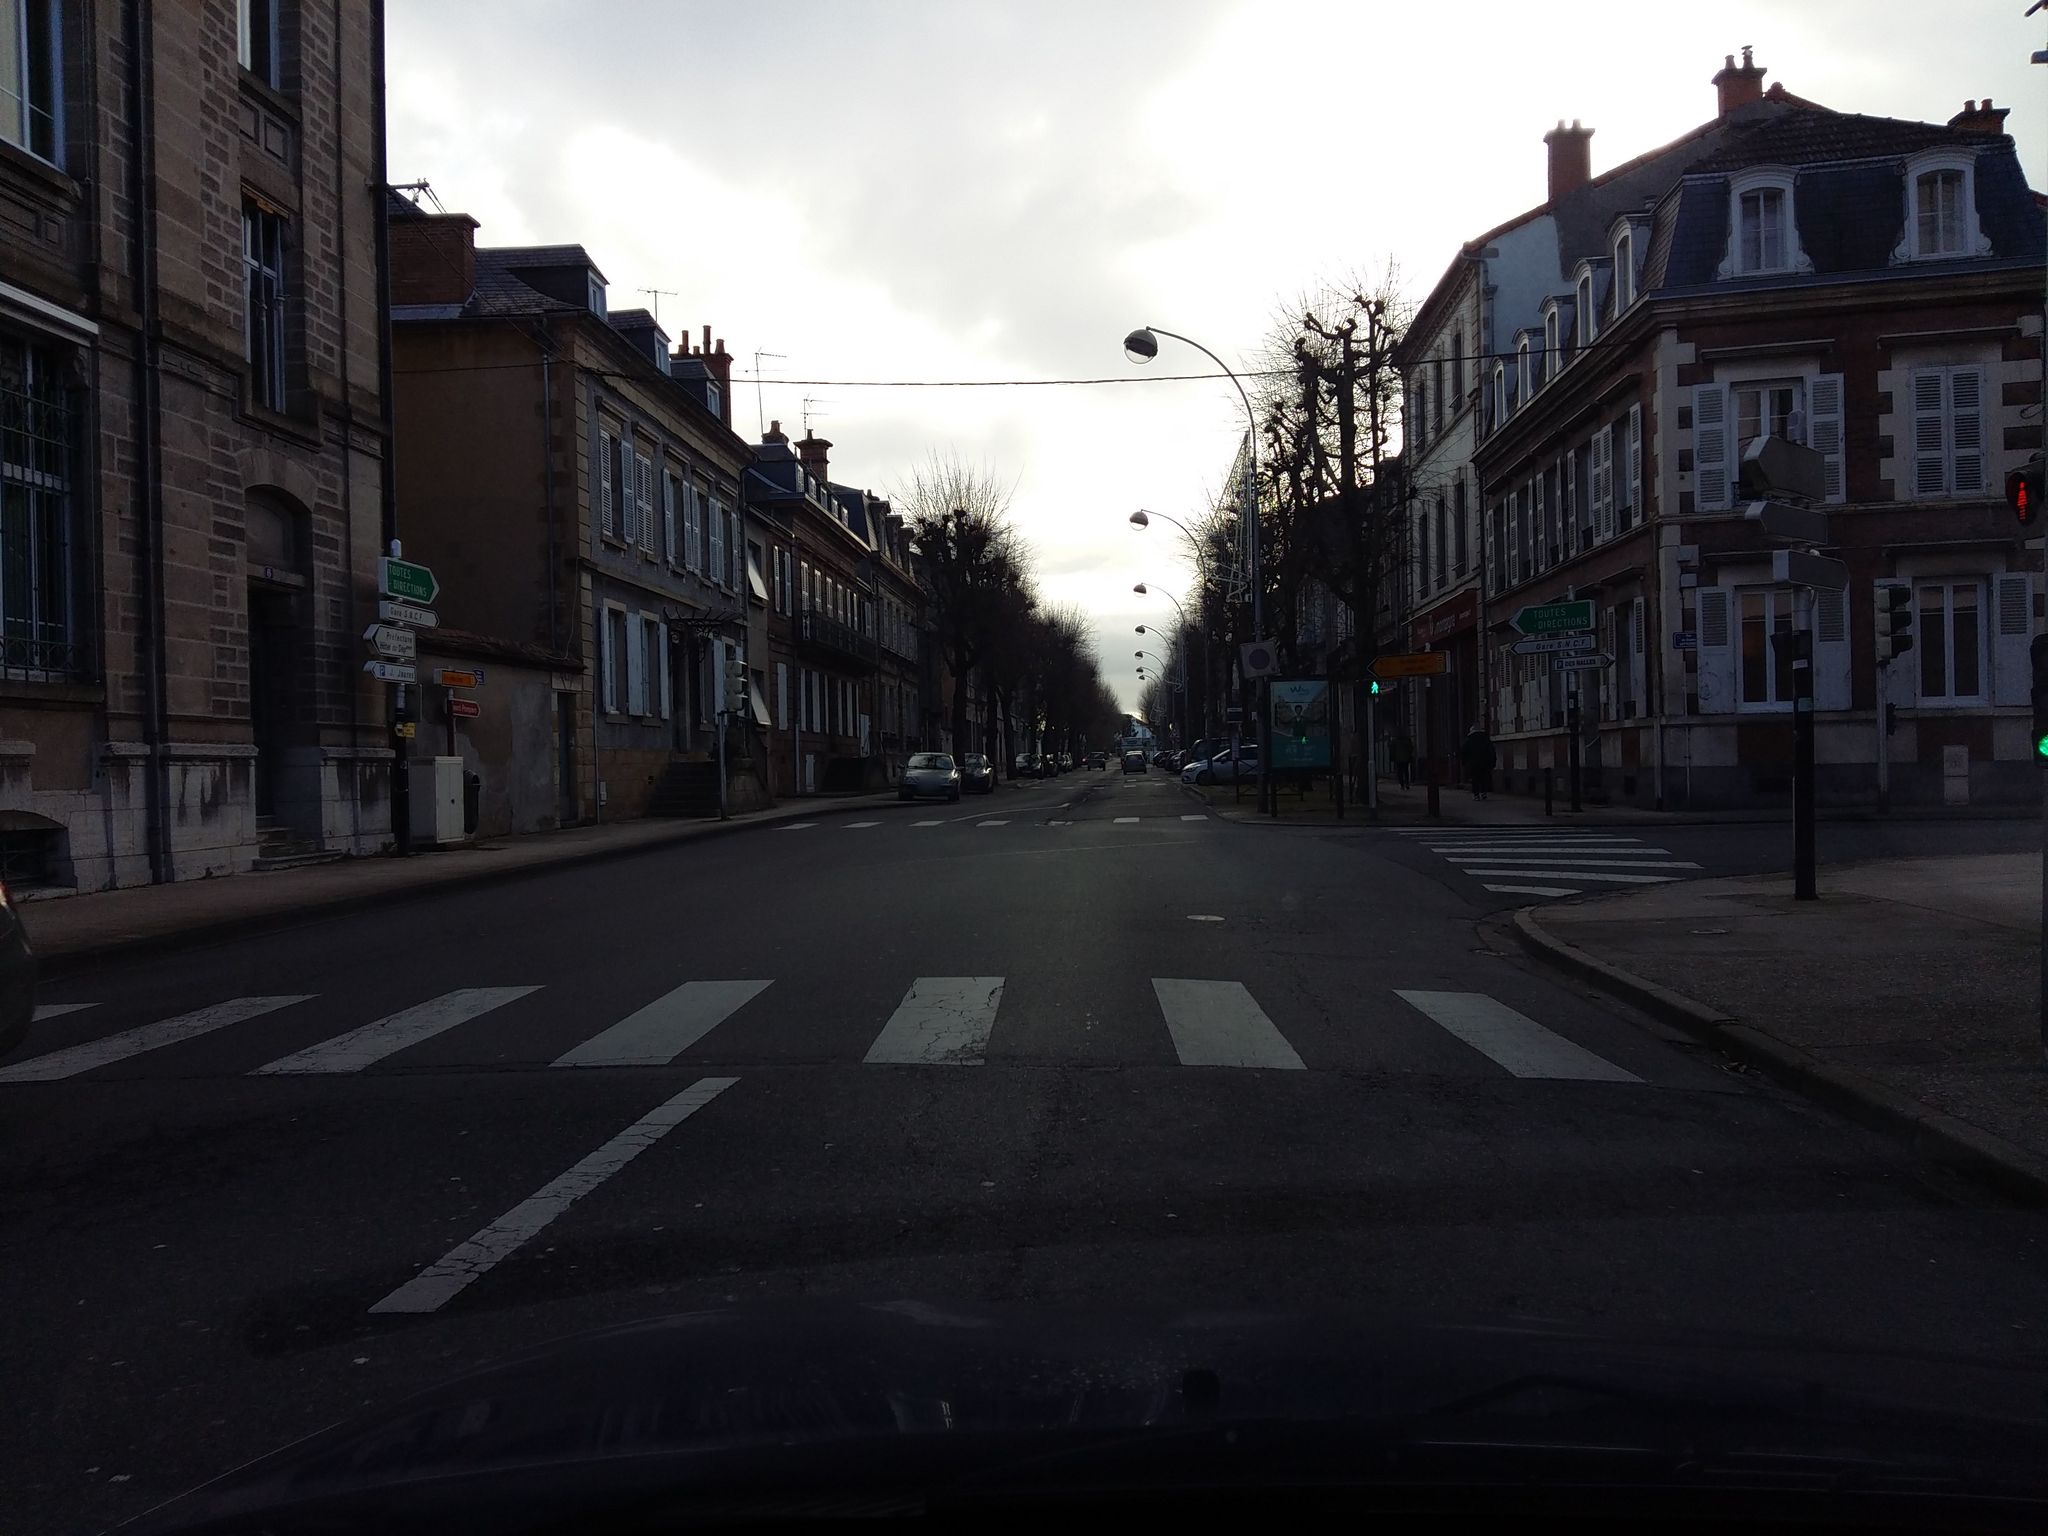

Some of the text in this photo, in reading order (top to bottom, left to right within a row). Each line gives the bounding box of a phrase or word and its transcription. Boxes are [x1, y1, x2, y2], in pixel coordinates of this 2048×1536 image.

[389, 564, 411, 579] TOUTES
[393, 580, 427, 597] DIRECTIONS
[1534, 607, 1567, 618] TOUTES
[1538, 616, 1588, 630] DIRECTIONS
